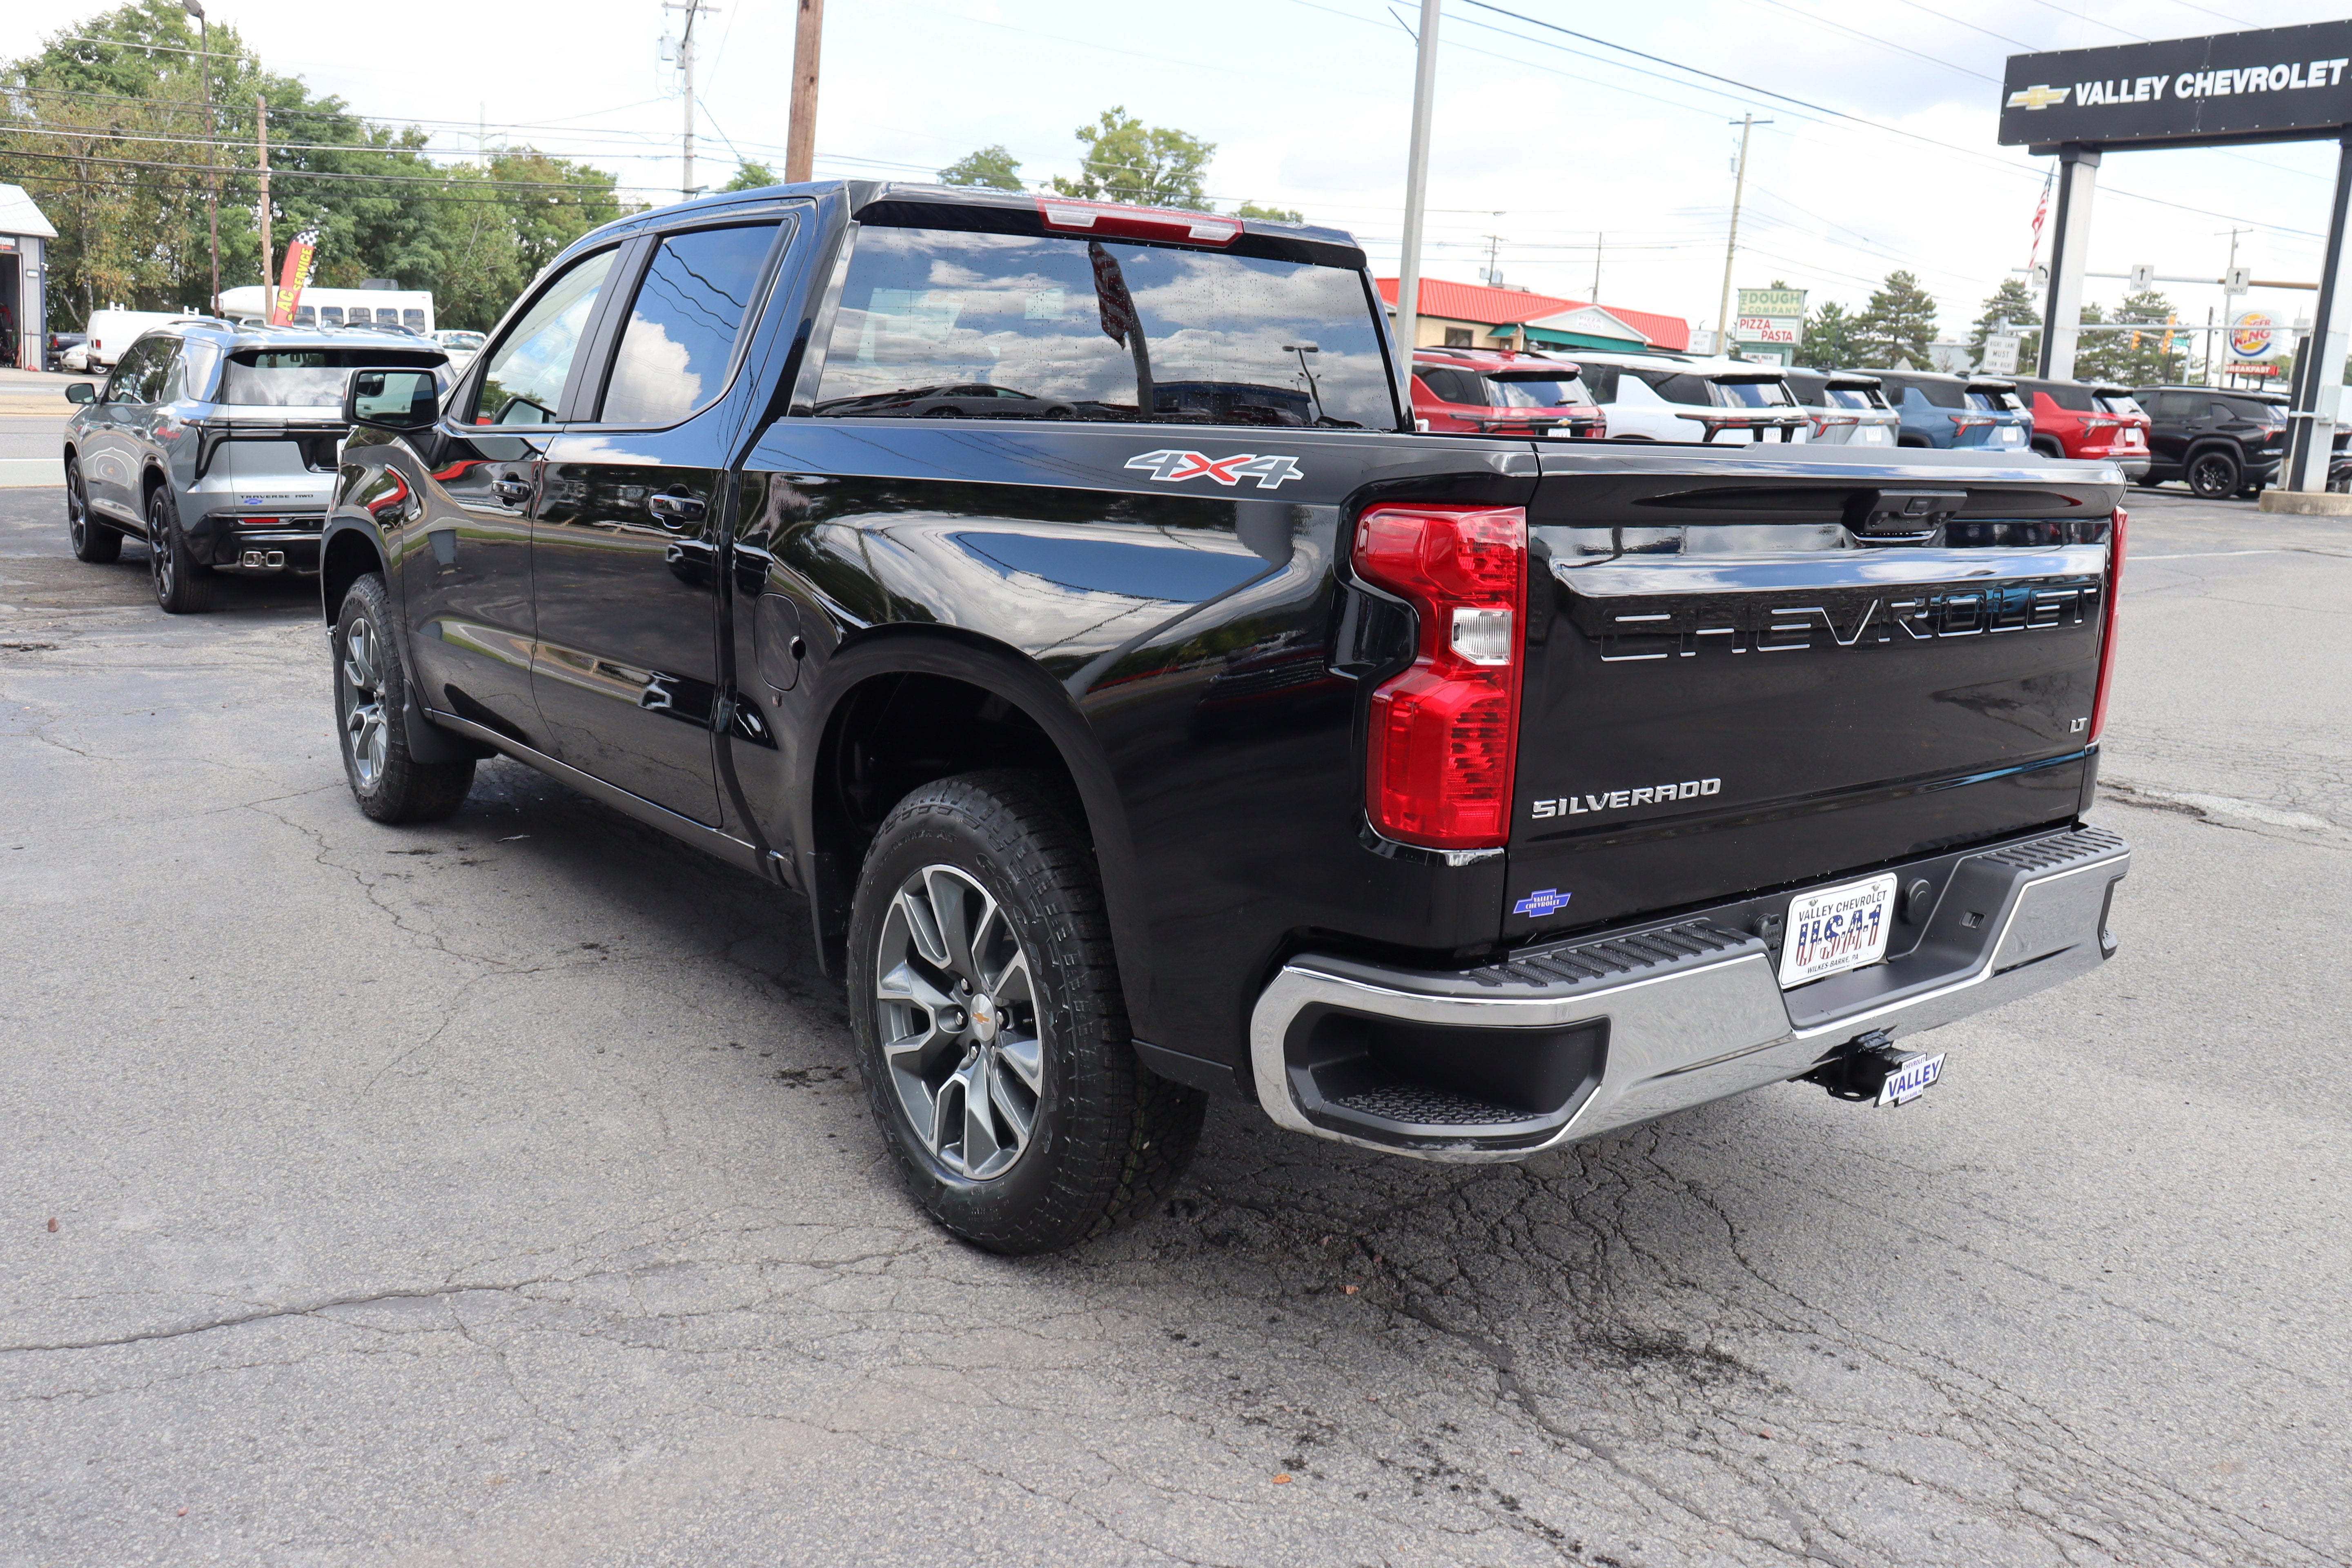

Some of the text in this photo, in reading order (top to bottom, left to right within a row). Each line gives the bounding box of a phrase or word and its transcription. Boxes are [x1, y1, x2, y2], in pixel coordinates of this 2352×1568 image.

[2075, 58, 2349, 107] VALLEY CHEVROLET
[292, 247, 312, 291] SERVICE
[277, 290, 294, 312] AC
[1749, 292, 1800, 304] DOUGH
[1740, 318, 1771, 329] PIZZA
[1761, 330, 1793, 342] PASTA
[2234, 329, 2271, 347] KNG
[1601, 580, 2097, 661] CHEVROLET
[2069, 717, 2088, 733] LT
[1532, 778, 1721, 819] SILVERADO
[1525, 899, 1559, 909] CHEVROLET
[1799, 890, 1887, 922] VALLEY CHEVROLET
[1807, 956, 1850, 974] WILKES-BARRE,
[1904, 1057, 1925, 1070] CHEVROLET
[1889, 1060, 1940, 1098] VALLEY
